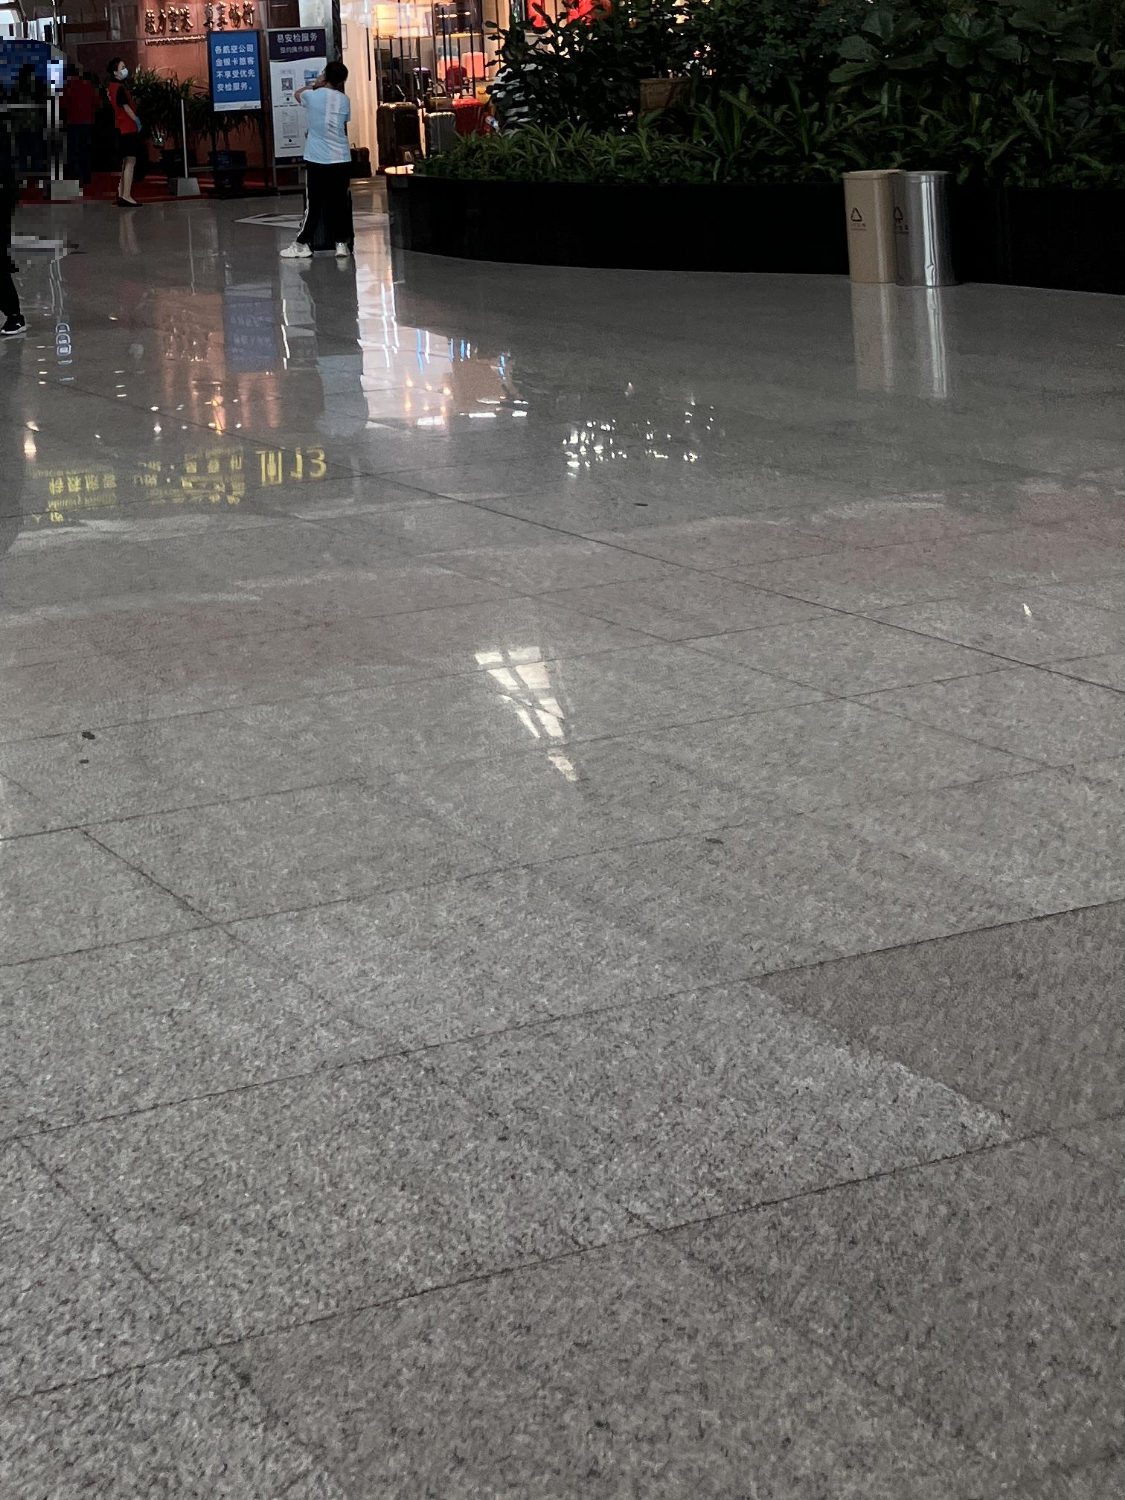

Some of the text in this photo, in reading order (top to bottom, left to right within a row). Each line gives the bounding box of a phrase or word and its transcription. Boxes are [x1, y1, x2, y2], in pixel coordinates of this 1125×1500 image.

[215, 44, 254, 55] 各航空公司
[216, 69, 256, 79] 不享受优先
